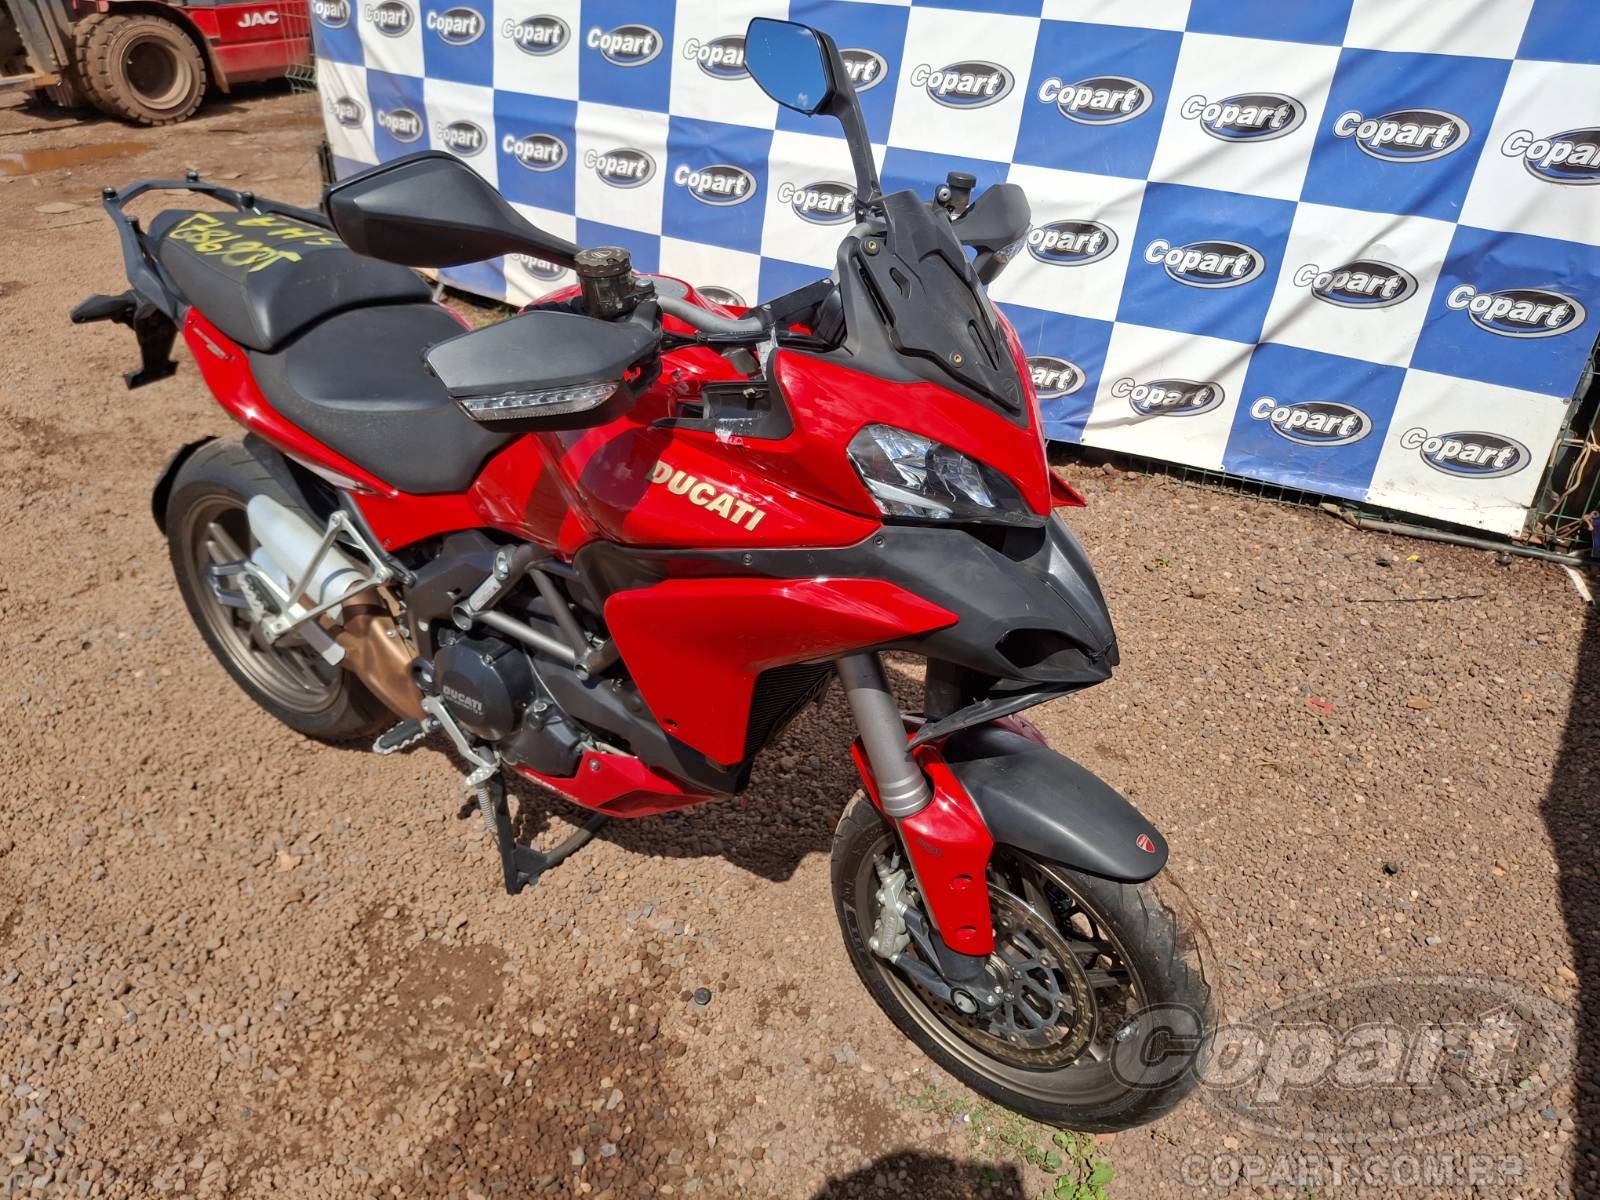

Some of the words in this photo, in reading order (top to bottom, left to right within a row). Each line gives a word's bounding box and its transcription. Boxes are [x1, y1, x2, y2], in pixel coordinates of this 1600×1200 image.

[238, 11, 280, 28] JAC
[366, 5, 408, 27] Copart
[426, 12, 477, 35] Copart
[502, 20, 561, 45] Copart
[587, 28, 653, 57] Copart
[683, 39, 745, 68] Copar
[911, 64, 1000, 97] Copart
[1038, 78, 1140, 112] Copart
[326, 98, 359, 119] Copa
[376, 112, 417, 133] Copart
[1181, 95, 1291, 129] Copart
[437, 123, 479, 145] Copart
[1333, 111, 1454, 149] Copart
[502, 136, 560, 160] Copart
[1501, 130, 1600, 169] Copa
[584, 150, 646, 178] Copart
[674, 166, 744, 194] Copart
[777, 182, 854, 213] Copart
[1027, 225, 1103, 256] opart
[1144, 239, 1250, 277] Copart
[1293, 264, 1400, 300] Copart
[1446, 286, 1569, 327] Copart
[1029, 366, 1071, 389] art
[1111, 378, 1209, 408] Copart
[1250, 397, 1357, 437] Copart
[1400, 427, 1517, 470] Copart
[651, 460, 765, 531] DUCATI
[443, 686, 483, 712] DUCATI
